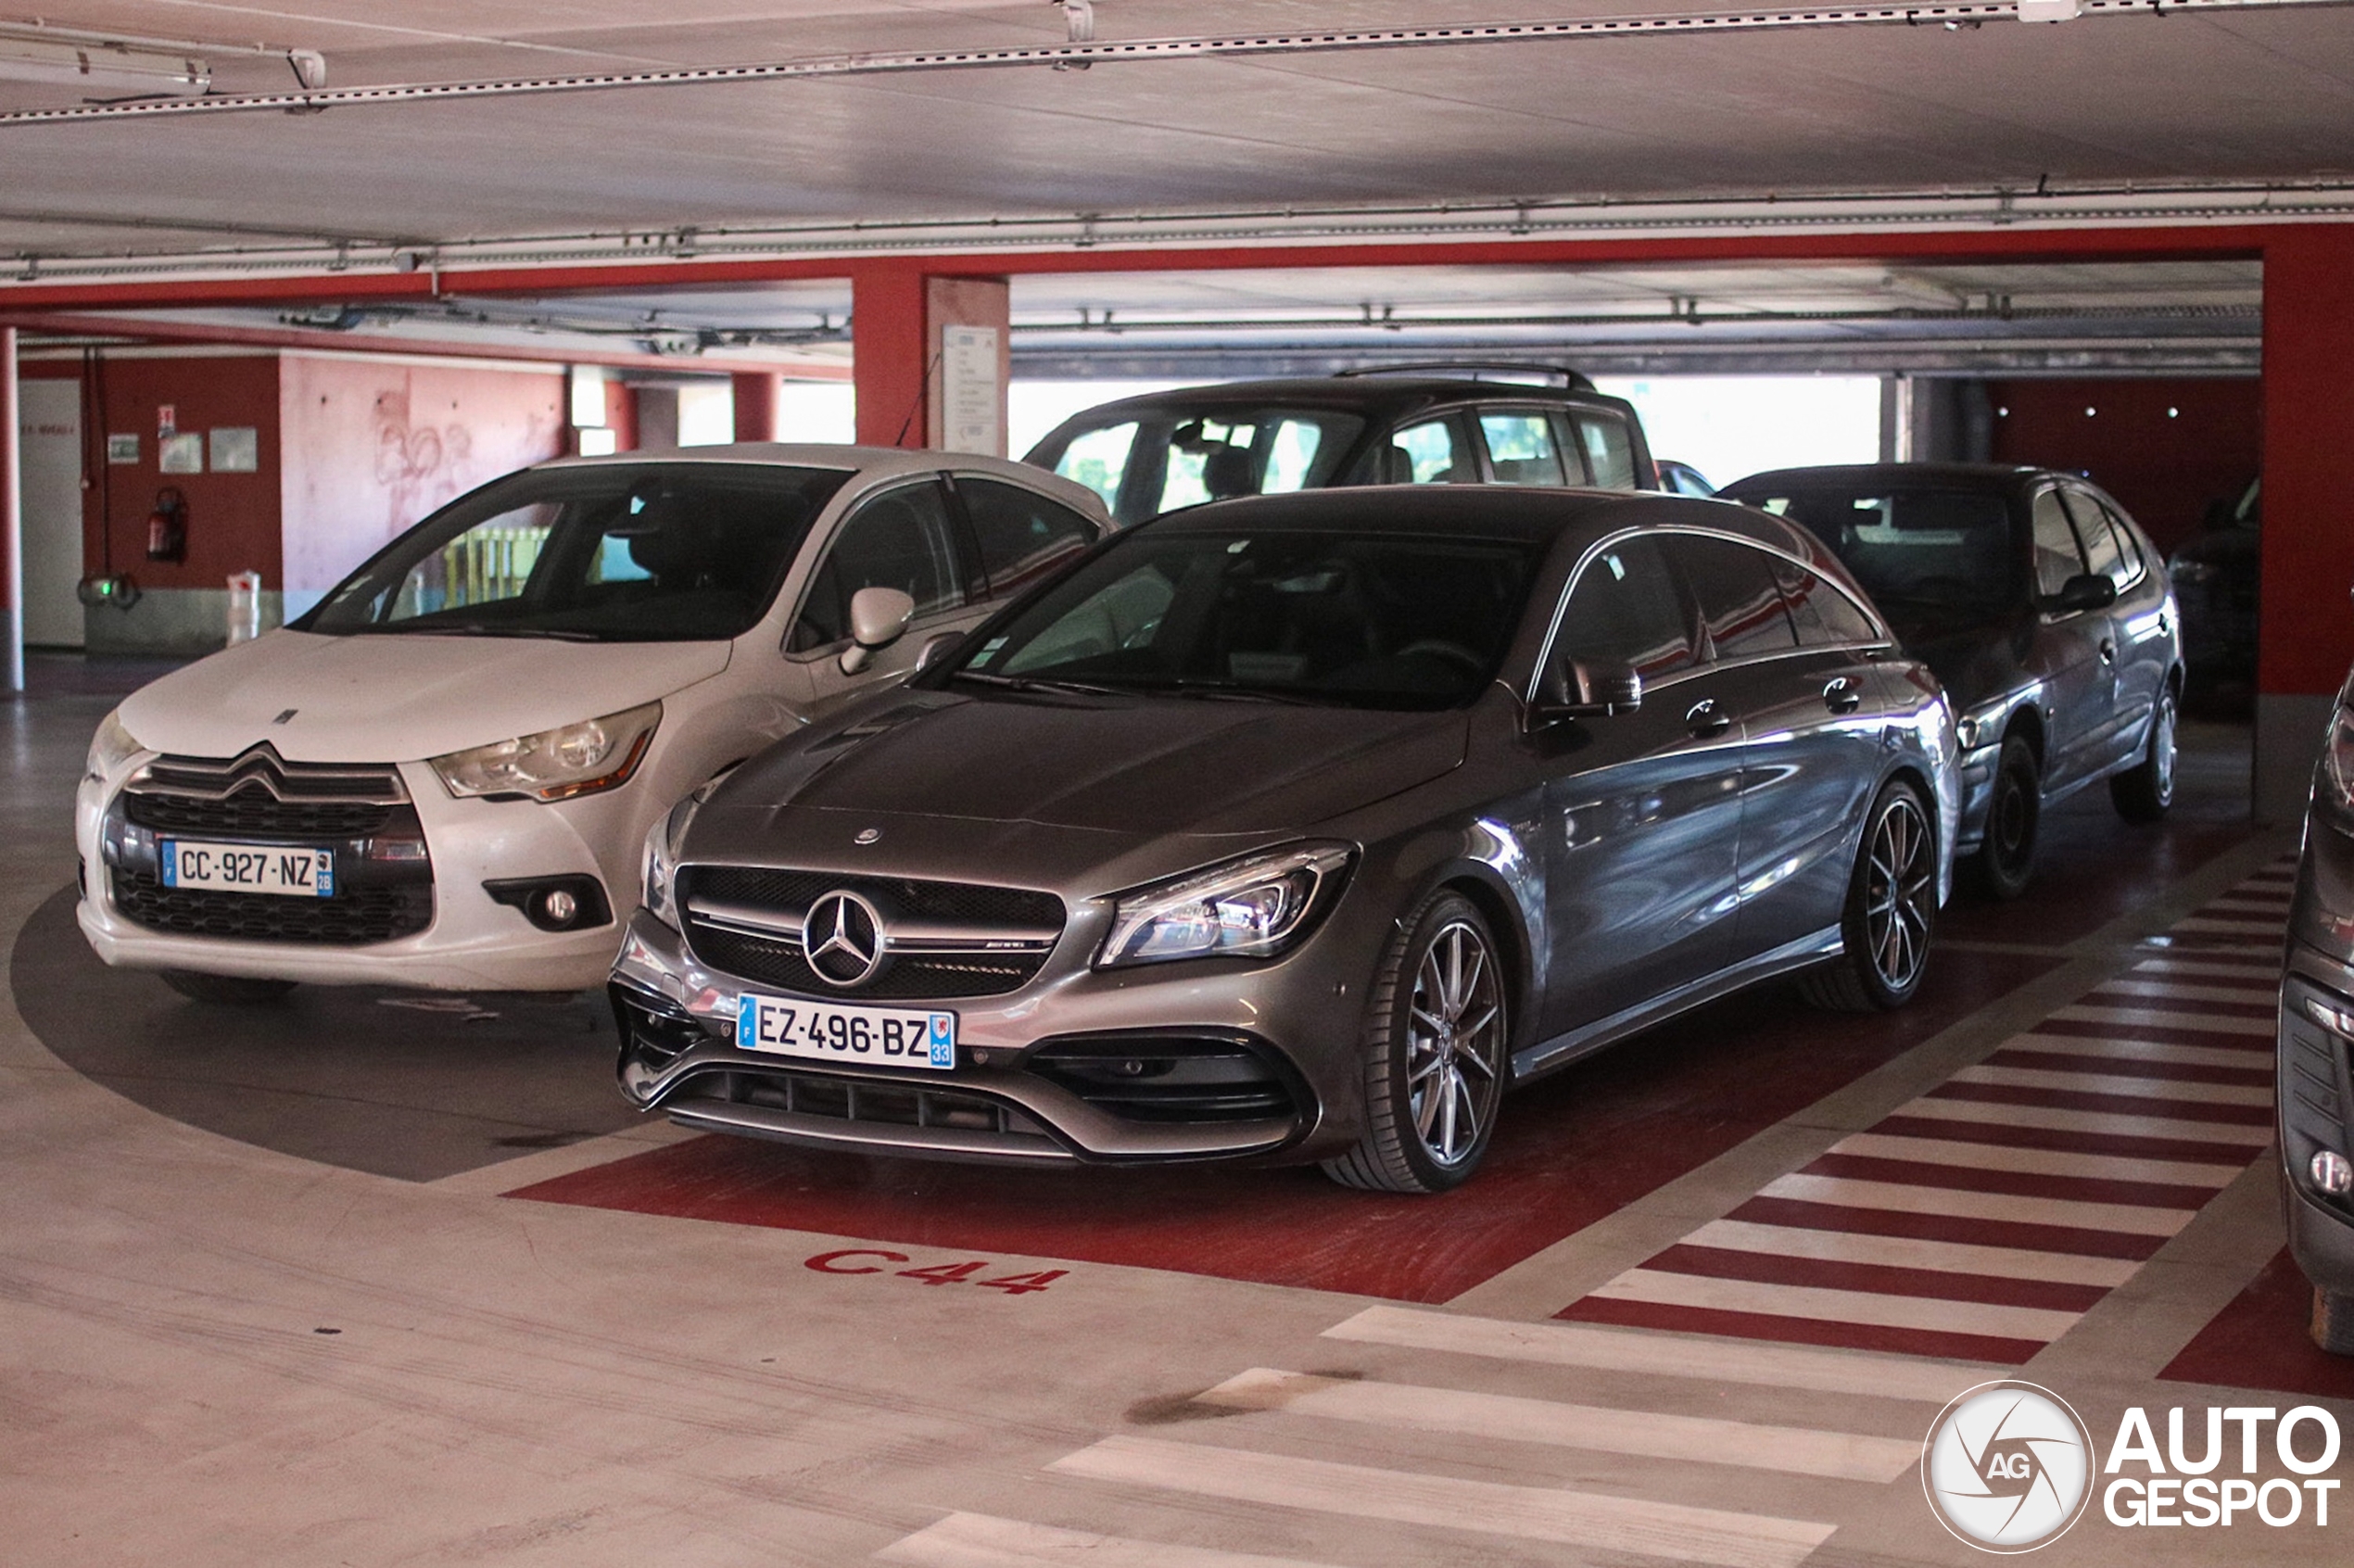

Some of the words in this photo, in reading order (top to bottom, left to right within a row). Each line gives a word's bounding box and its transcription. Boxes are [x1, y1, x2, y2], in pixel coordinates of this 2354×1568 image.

[181, 850, 312, 887] CC-927-NZ
[318, 874, 332, 891] 2B
[744, 1026, 751, 1039] F
[759, 1005, 929, 1058] EZ-496-BZ
[931, 1043, 951, 1063] 33
[804, 1248, 1070, 1295] C44
